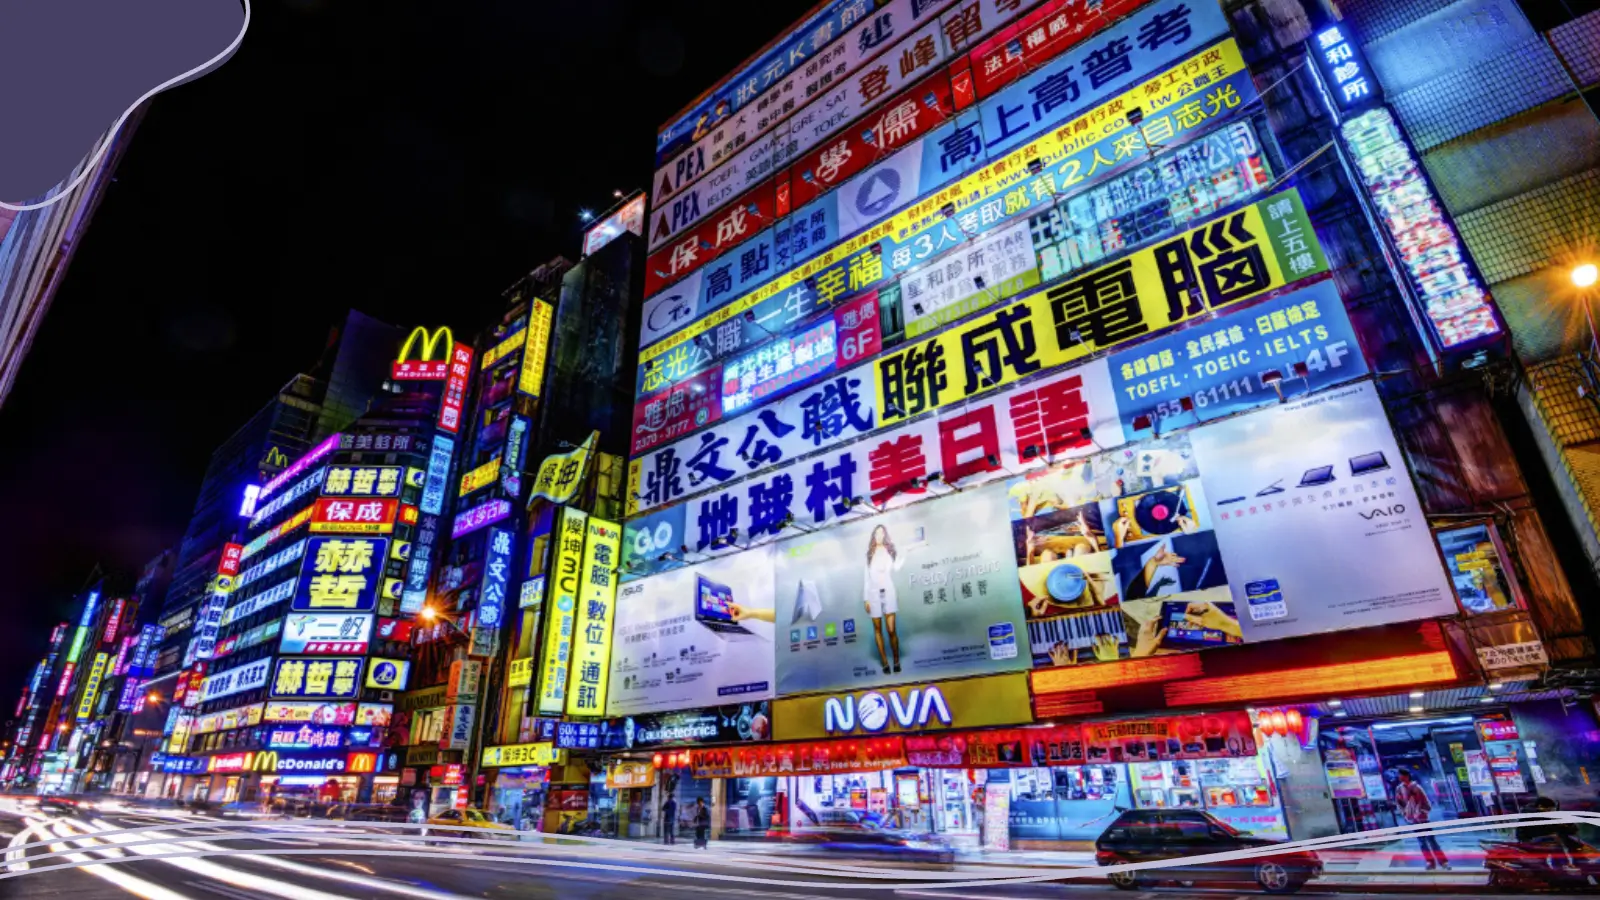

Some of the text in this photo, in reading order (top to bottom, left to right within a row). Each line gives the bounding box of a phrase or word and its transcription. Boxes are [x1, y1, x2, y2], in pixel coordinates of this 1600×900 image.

[983, 15, 1071, 76] 法權威
[1316, 26, 1369, 102] 星和診所
[825, 89, 849, 111] SAT
[937, 3, 1193, 174] 高上高普考
[1176, 63, 1229, 98] 公職王
[815, 99, 921, 182] 學儒
[669, 204, 749, 275] 保成
[775, 207, 826, 244] 研究所
[986, 231, 1024, 253] STAR
[1268, 198, 1318, 275] 請上五樓
[705, 242, 770, 304] 高點
[907, 250, 985, 299] 星和診所
[878, 210, 1273, 420] 聯成電腦
[841, 327, 875, 361] 6F
[1120, 300, 1321, 381] 各級會話 全民英檢 日語檢定
[1125, 324, 1330, 401] TOEFL TOEIC IELTS
[1306, 339, 1349, 374] 4F
[645, 376, 875, 506] 鼎文公職
[326, 500, 384, 522] 保成
[590, 524, 621, 542] NOVA
[1358, 503, 1407, 521] VAIO
[558, 514, 583, 594] 燦坤3C
[589, 542, 614, 588] 電腦
[620, 583, 644, 598] ASUS
[583, 598, 608, 645] 數位
[576, 661, 602, 710] 通訊
[825, 685, 952, 733] NOVA
[644, 720, 718, 742] audio-technica
[252, 750, 345, 772] McDonald's
